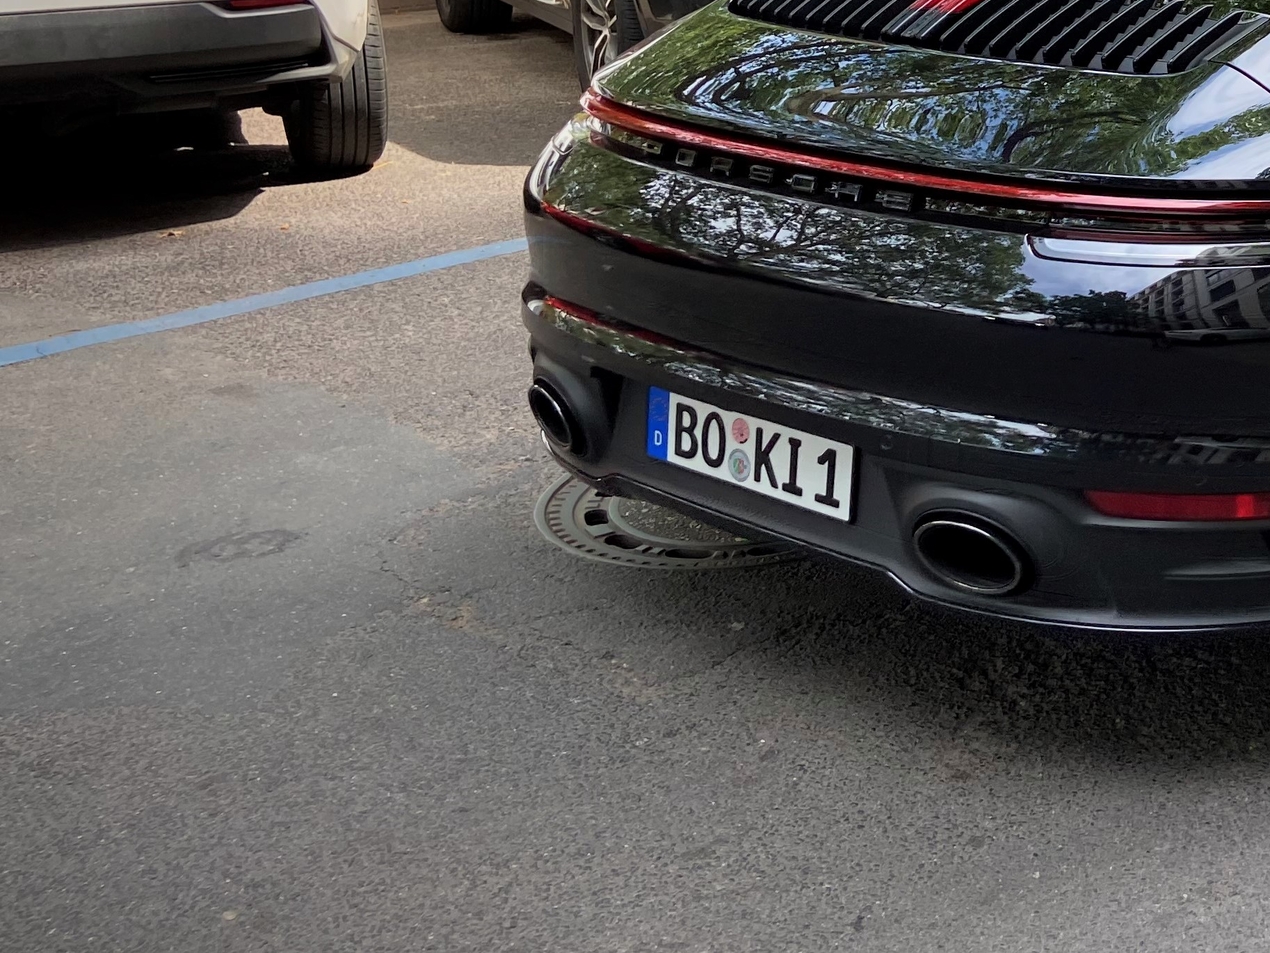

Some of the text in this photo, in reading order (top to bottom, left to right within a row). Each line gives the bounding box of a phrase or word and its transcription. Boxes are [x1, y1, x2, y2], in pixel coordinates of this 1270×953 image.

[654, 402, 840, 508] D BO KI 1
